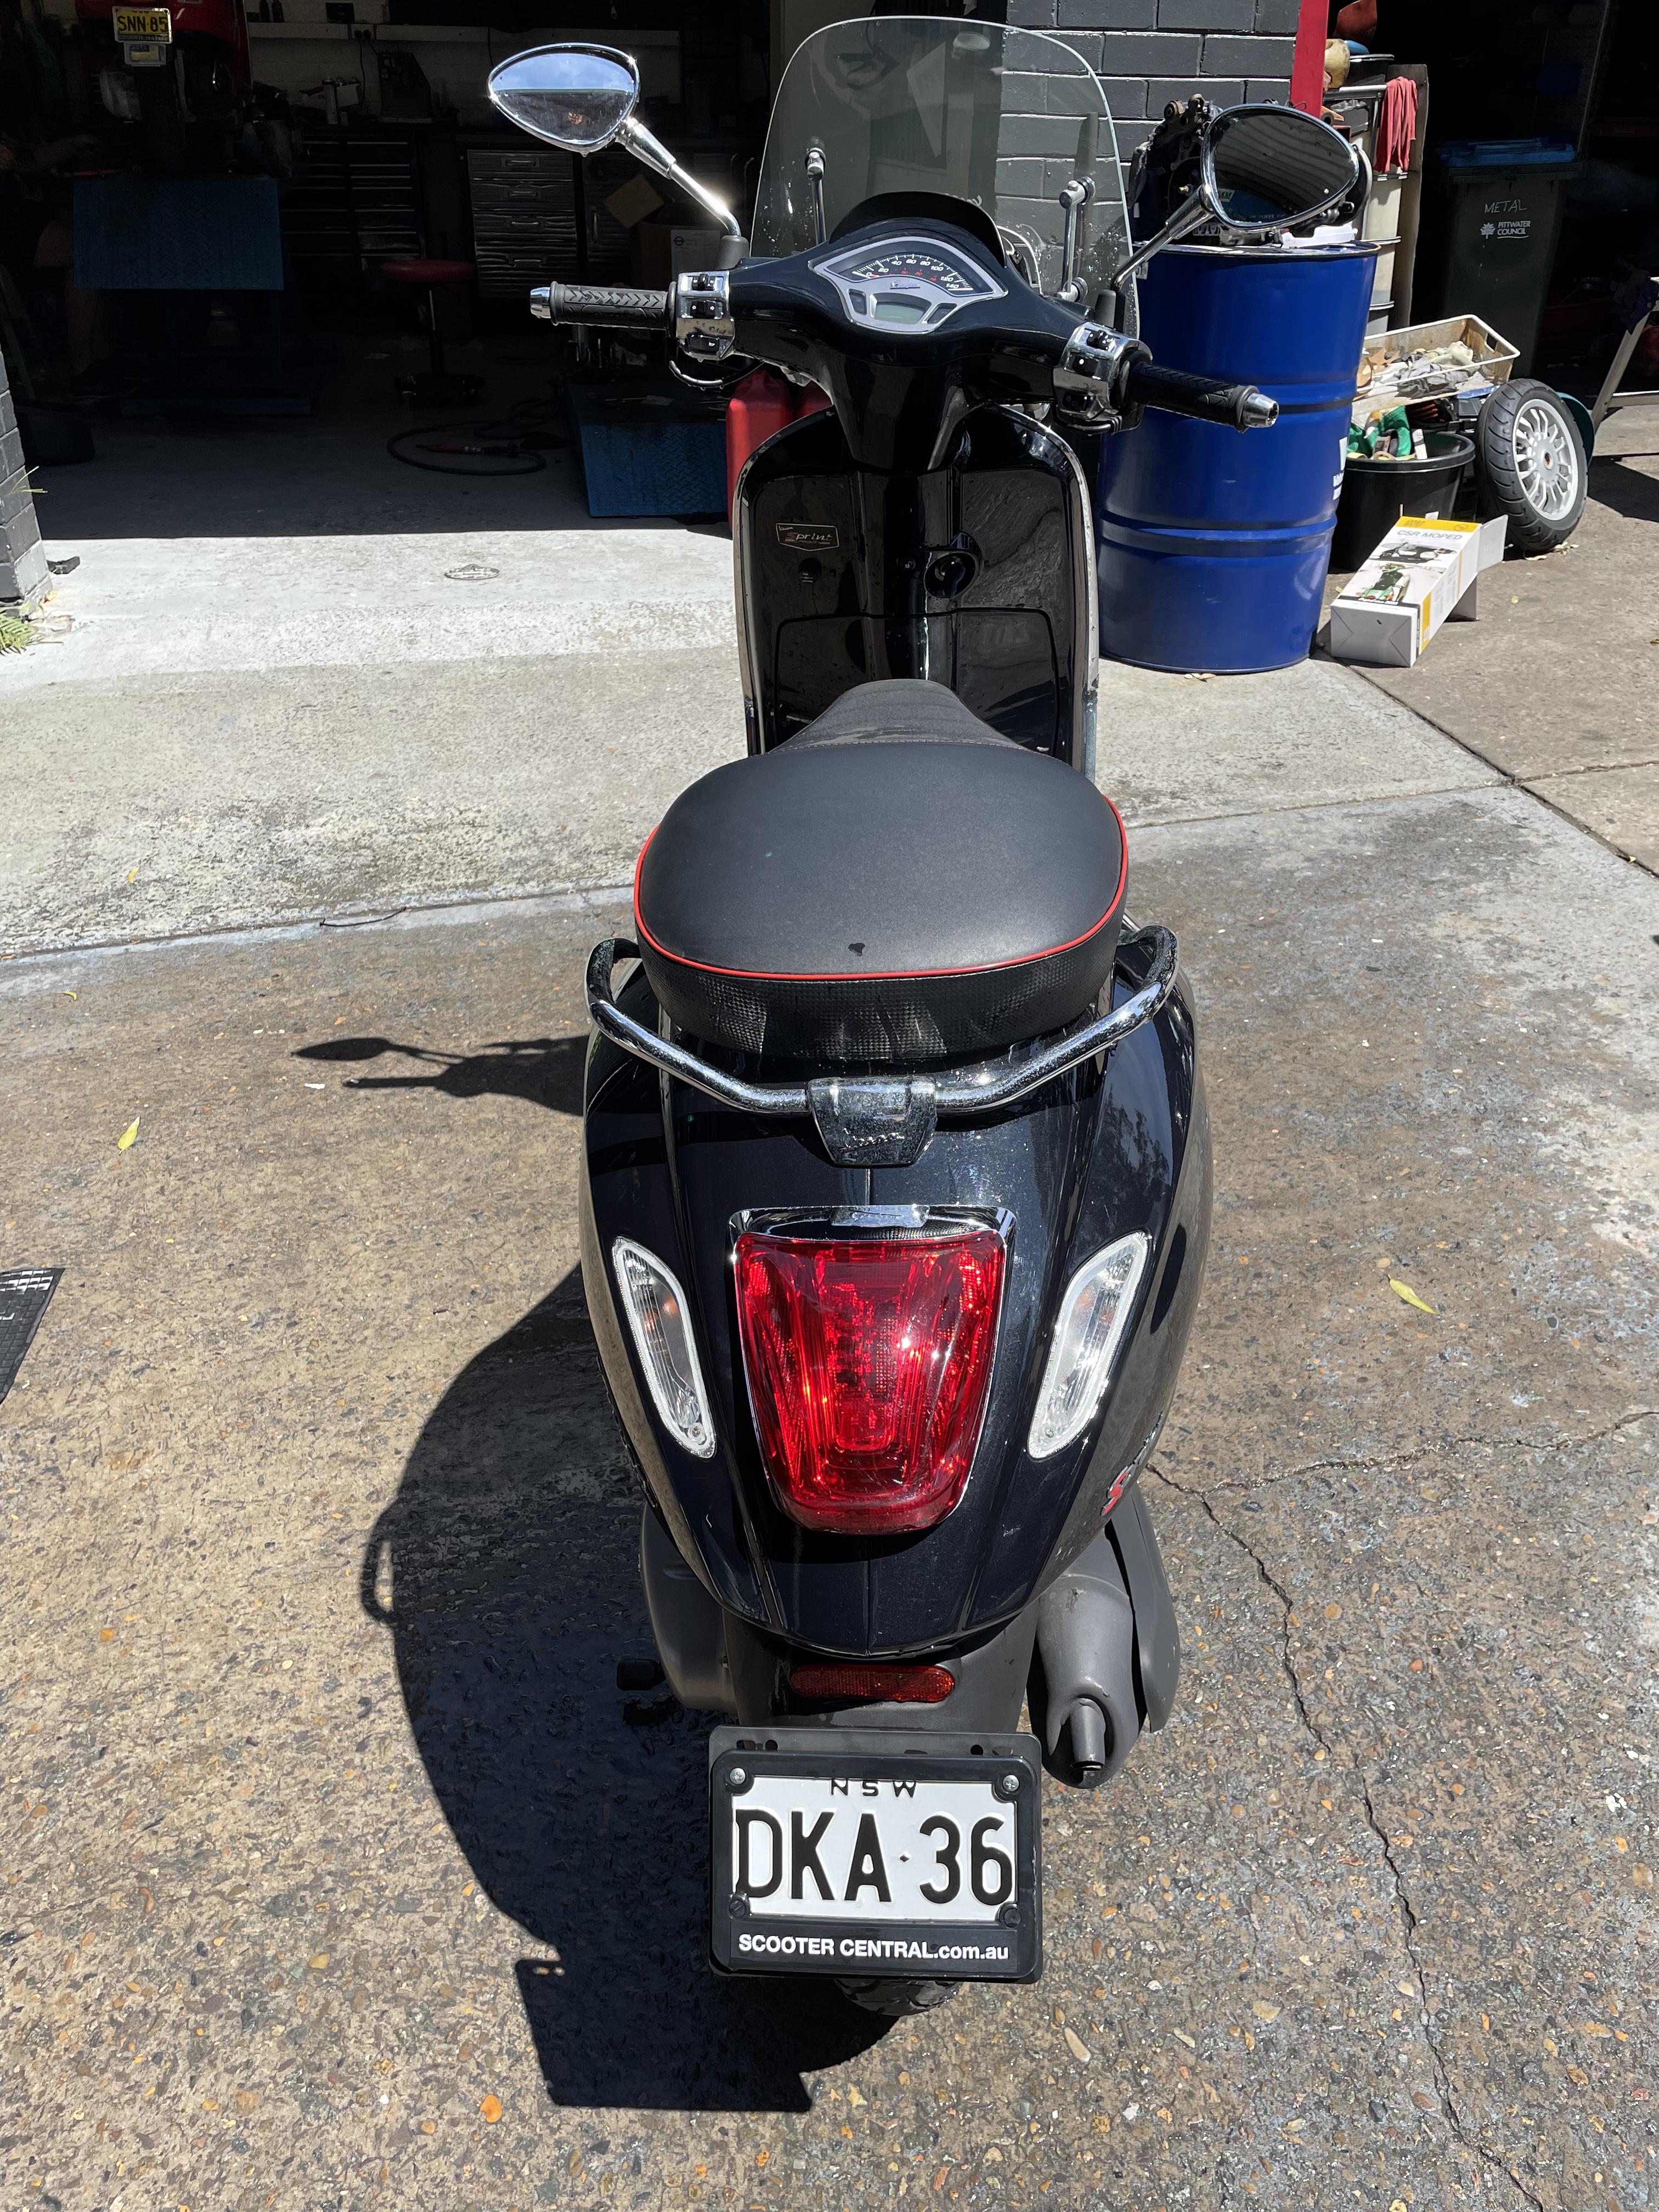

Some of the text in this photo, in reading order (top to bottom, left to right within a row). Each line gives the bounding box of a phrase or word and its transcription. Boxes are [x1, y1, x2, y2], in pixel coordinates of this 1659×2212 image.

[1485, 199, 1527, 213] METAL
[785, 532, 832, 541] Sprint
[738, 1934, 1009, 1960] SCOOTER CENTRAL.com.au
